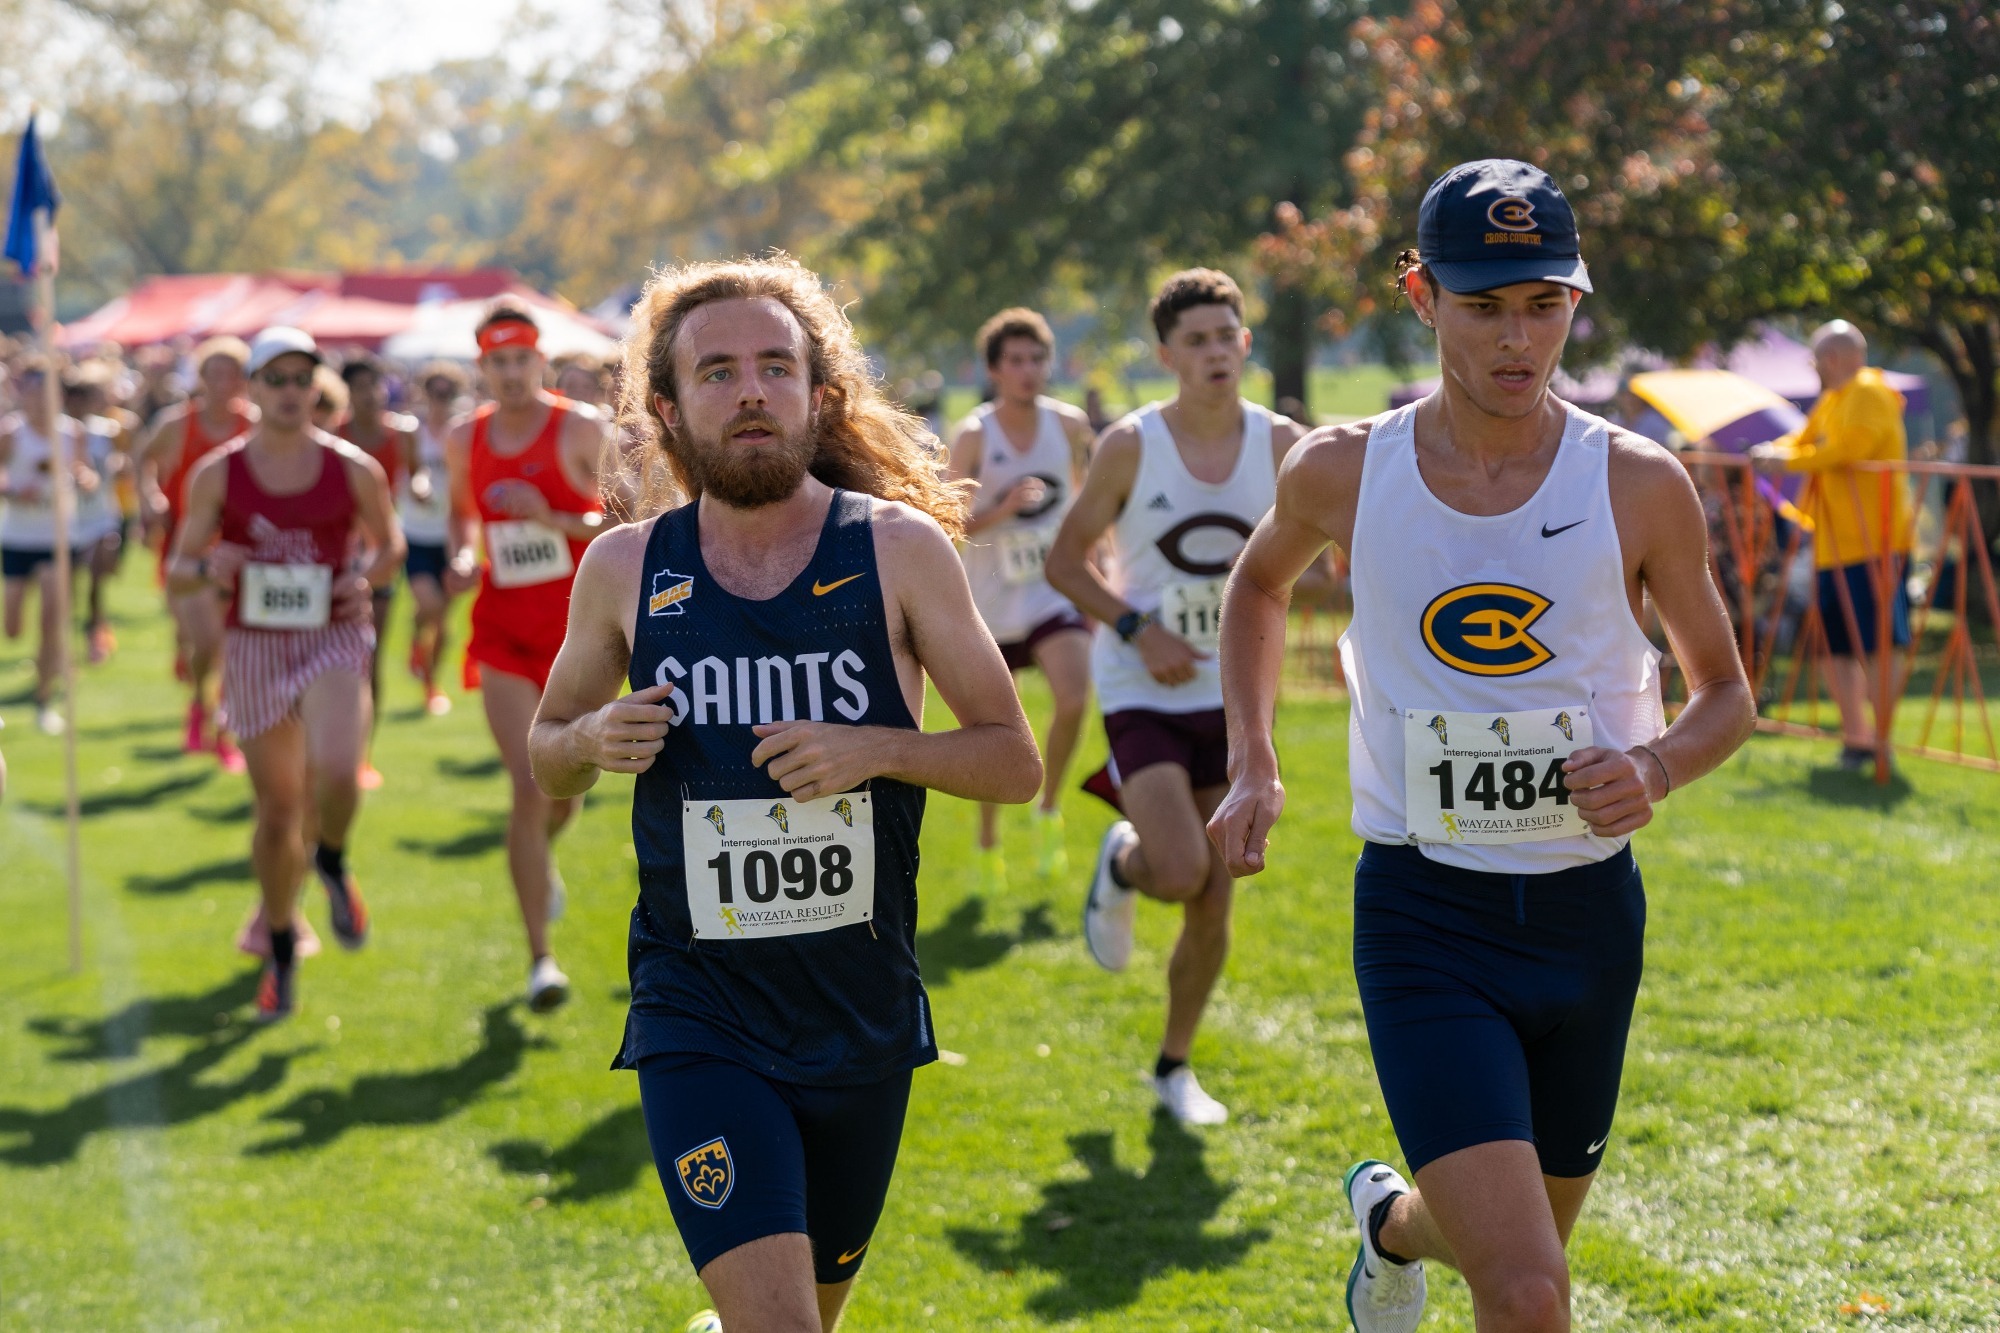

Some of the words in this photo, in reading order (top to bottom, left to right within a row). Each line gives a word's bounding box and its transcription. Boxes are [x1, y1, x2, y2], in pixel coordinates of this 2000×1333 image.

[1485, 232, 1508, 244] CROSS
[1509, 232, 1542, 245] COUNTRY
[651, 580, 692, 614] MIAC
[655, 649, 869, 727] SAINTS
[1443, 748, 1502, 759] Interregional
[1504, 746, 1555, 757] Invitational
[1429, 757, 1570, 811] 1484
[1457, 818, 1513, 829] WAYZATA
[1516, 813, 1564, 828] RESULTS
[721, 838, 781, 848] Interregional
[783, 833, 835, 845] Invitational
[707, 844, 853, 904] 1098
[737, 910, 794, 921] WAYZATA
[797, 902, 845, 918] RESULTS
